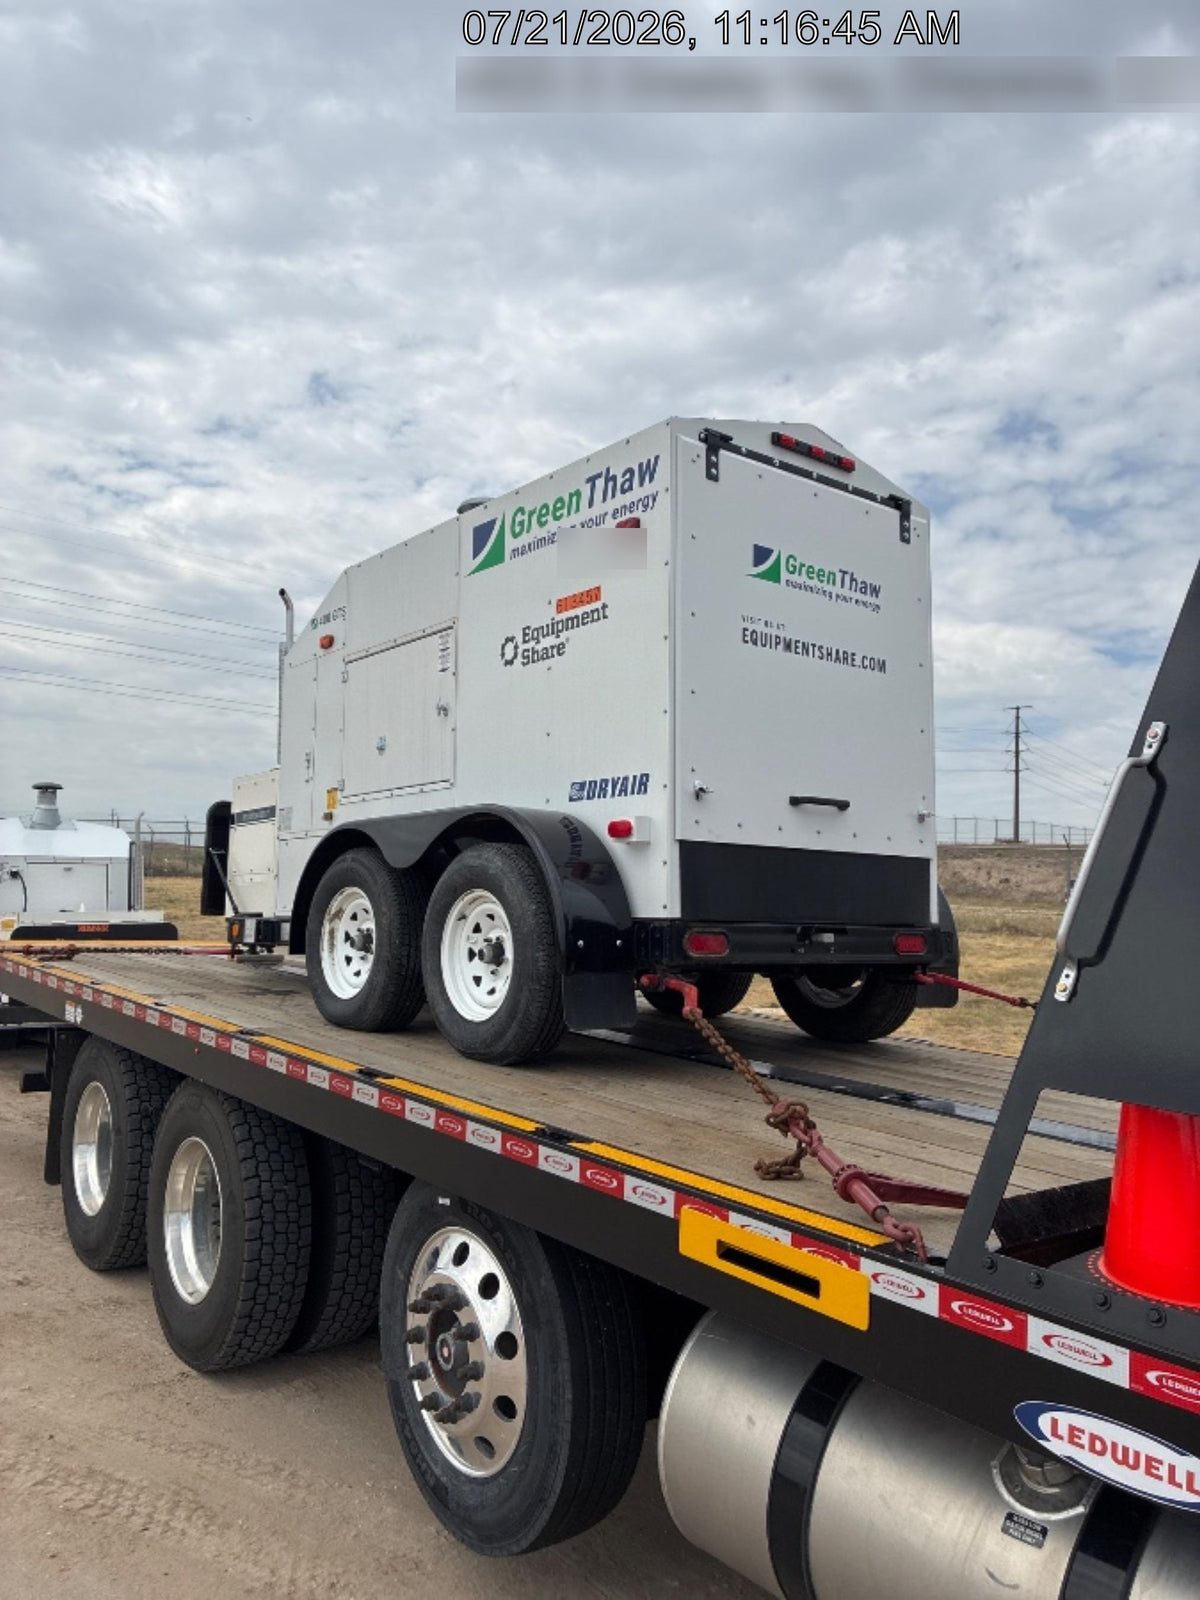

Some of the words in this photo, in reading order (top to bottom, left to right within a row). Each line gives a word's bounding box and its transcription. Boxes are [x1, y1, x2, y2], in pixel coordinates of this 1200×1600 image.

[510, 455, 660, 539] GreenThaw
[611, 491, 659, 520] energy
[785, 554, 881, 599] GreenThaw
[522, 602, 608, 645] Equipment
[521, 641, 566, 667] Share
[742, 627, 886, 674] EQUIPMENTSHARE.COM
[586, 773, 650, 801] DRYAIR
[1057, 1340, 1099, 1361] LEDWELL
[1162, 1376, 1200, 1397] LEDWE
[1050, 1416, 1200, 1497] LEDWELL
